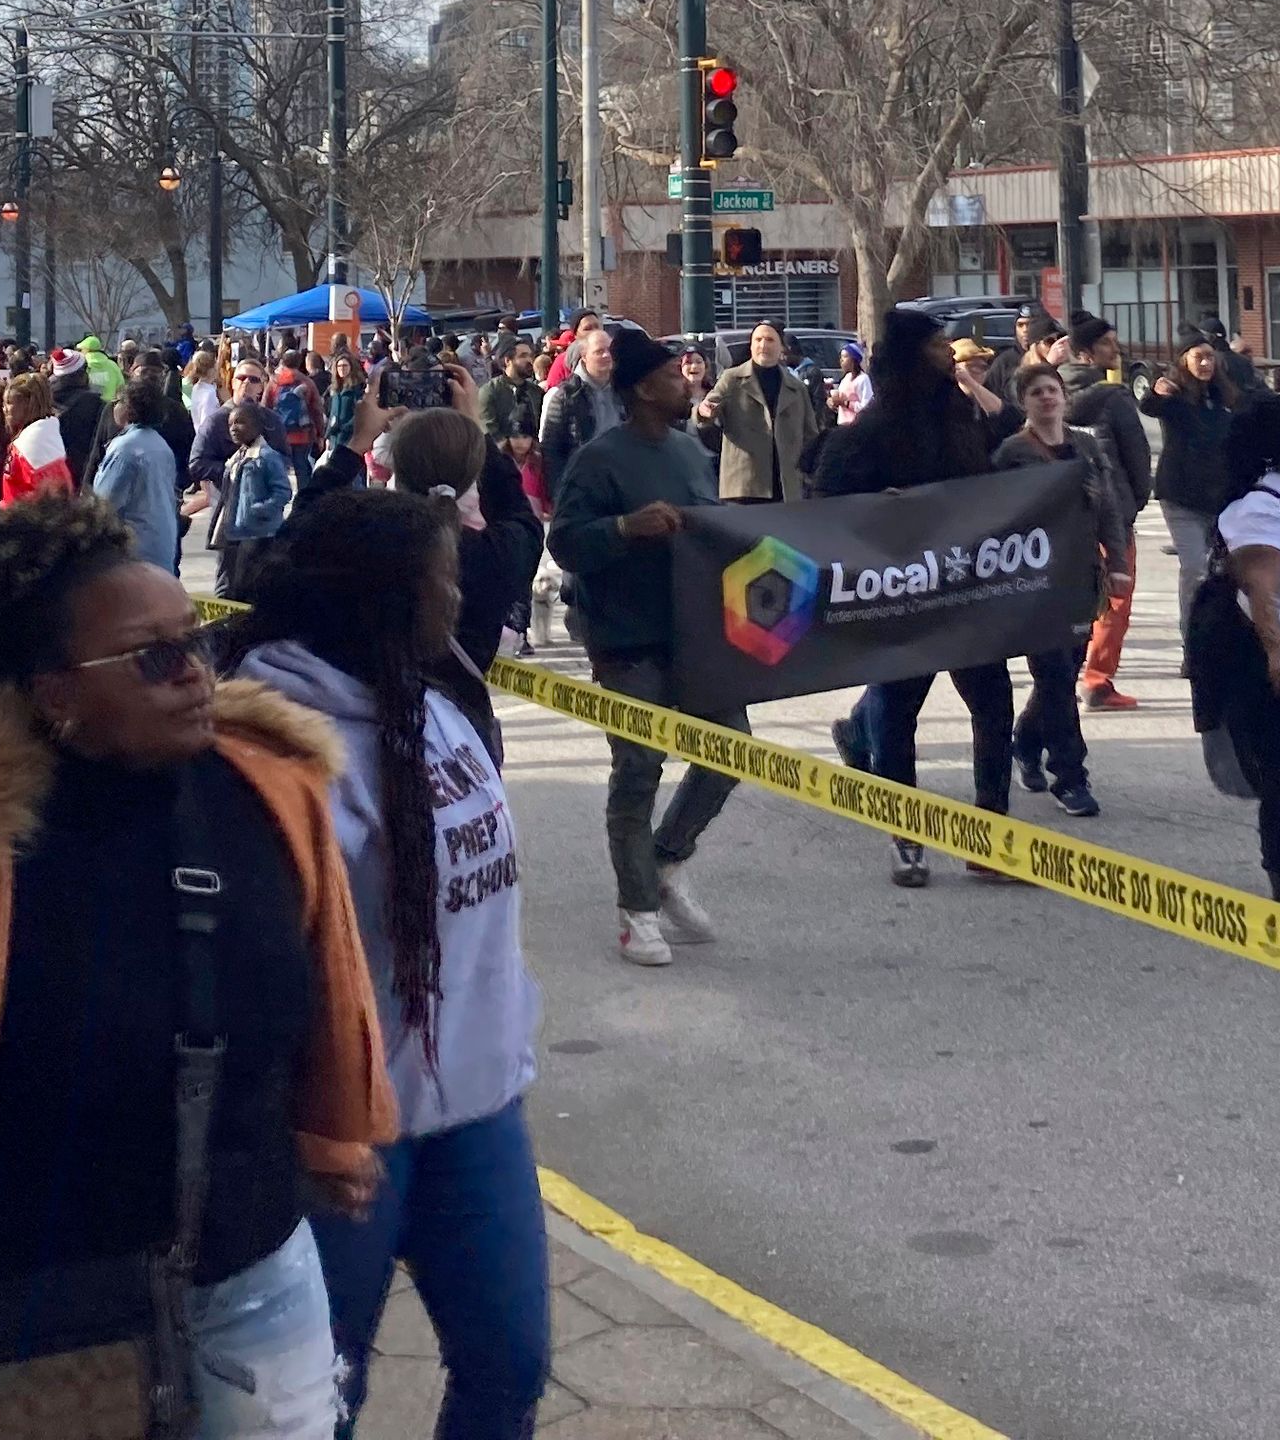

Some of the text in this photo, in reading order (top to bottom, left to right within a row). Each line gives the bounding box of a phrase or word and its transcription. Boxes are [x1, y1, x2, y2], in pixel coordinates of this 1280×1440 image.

[717, 193, 759, 209] Jackson
[755, 259, 840, 276] CLEANERS
[830, 527, 1051, 603] Local 600
[552, 682, 654, 740] CRIME SCENE DO NOT CROSS
[674, 722, 802, 792] CRIME SCENE DO NOT CROSS
[442, 811, 498, 865] PREP
[830, 773, 993, 859] CRIME SCENE DO NOT CROSS
[444, 852, 519, 913] SCHOO
[1029, 838, 1247, 947] CRIME SCENE DO NOT CROSS
